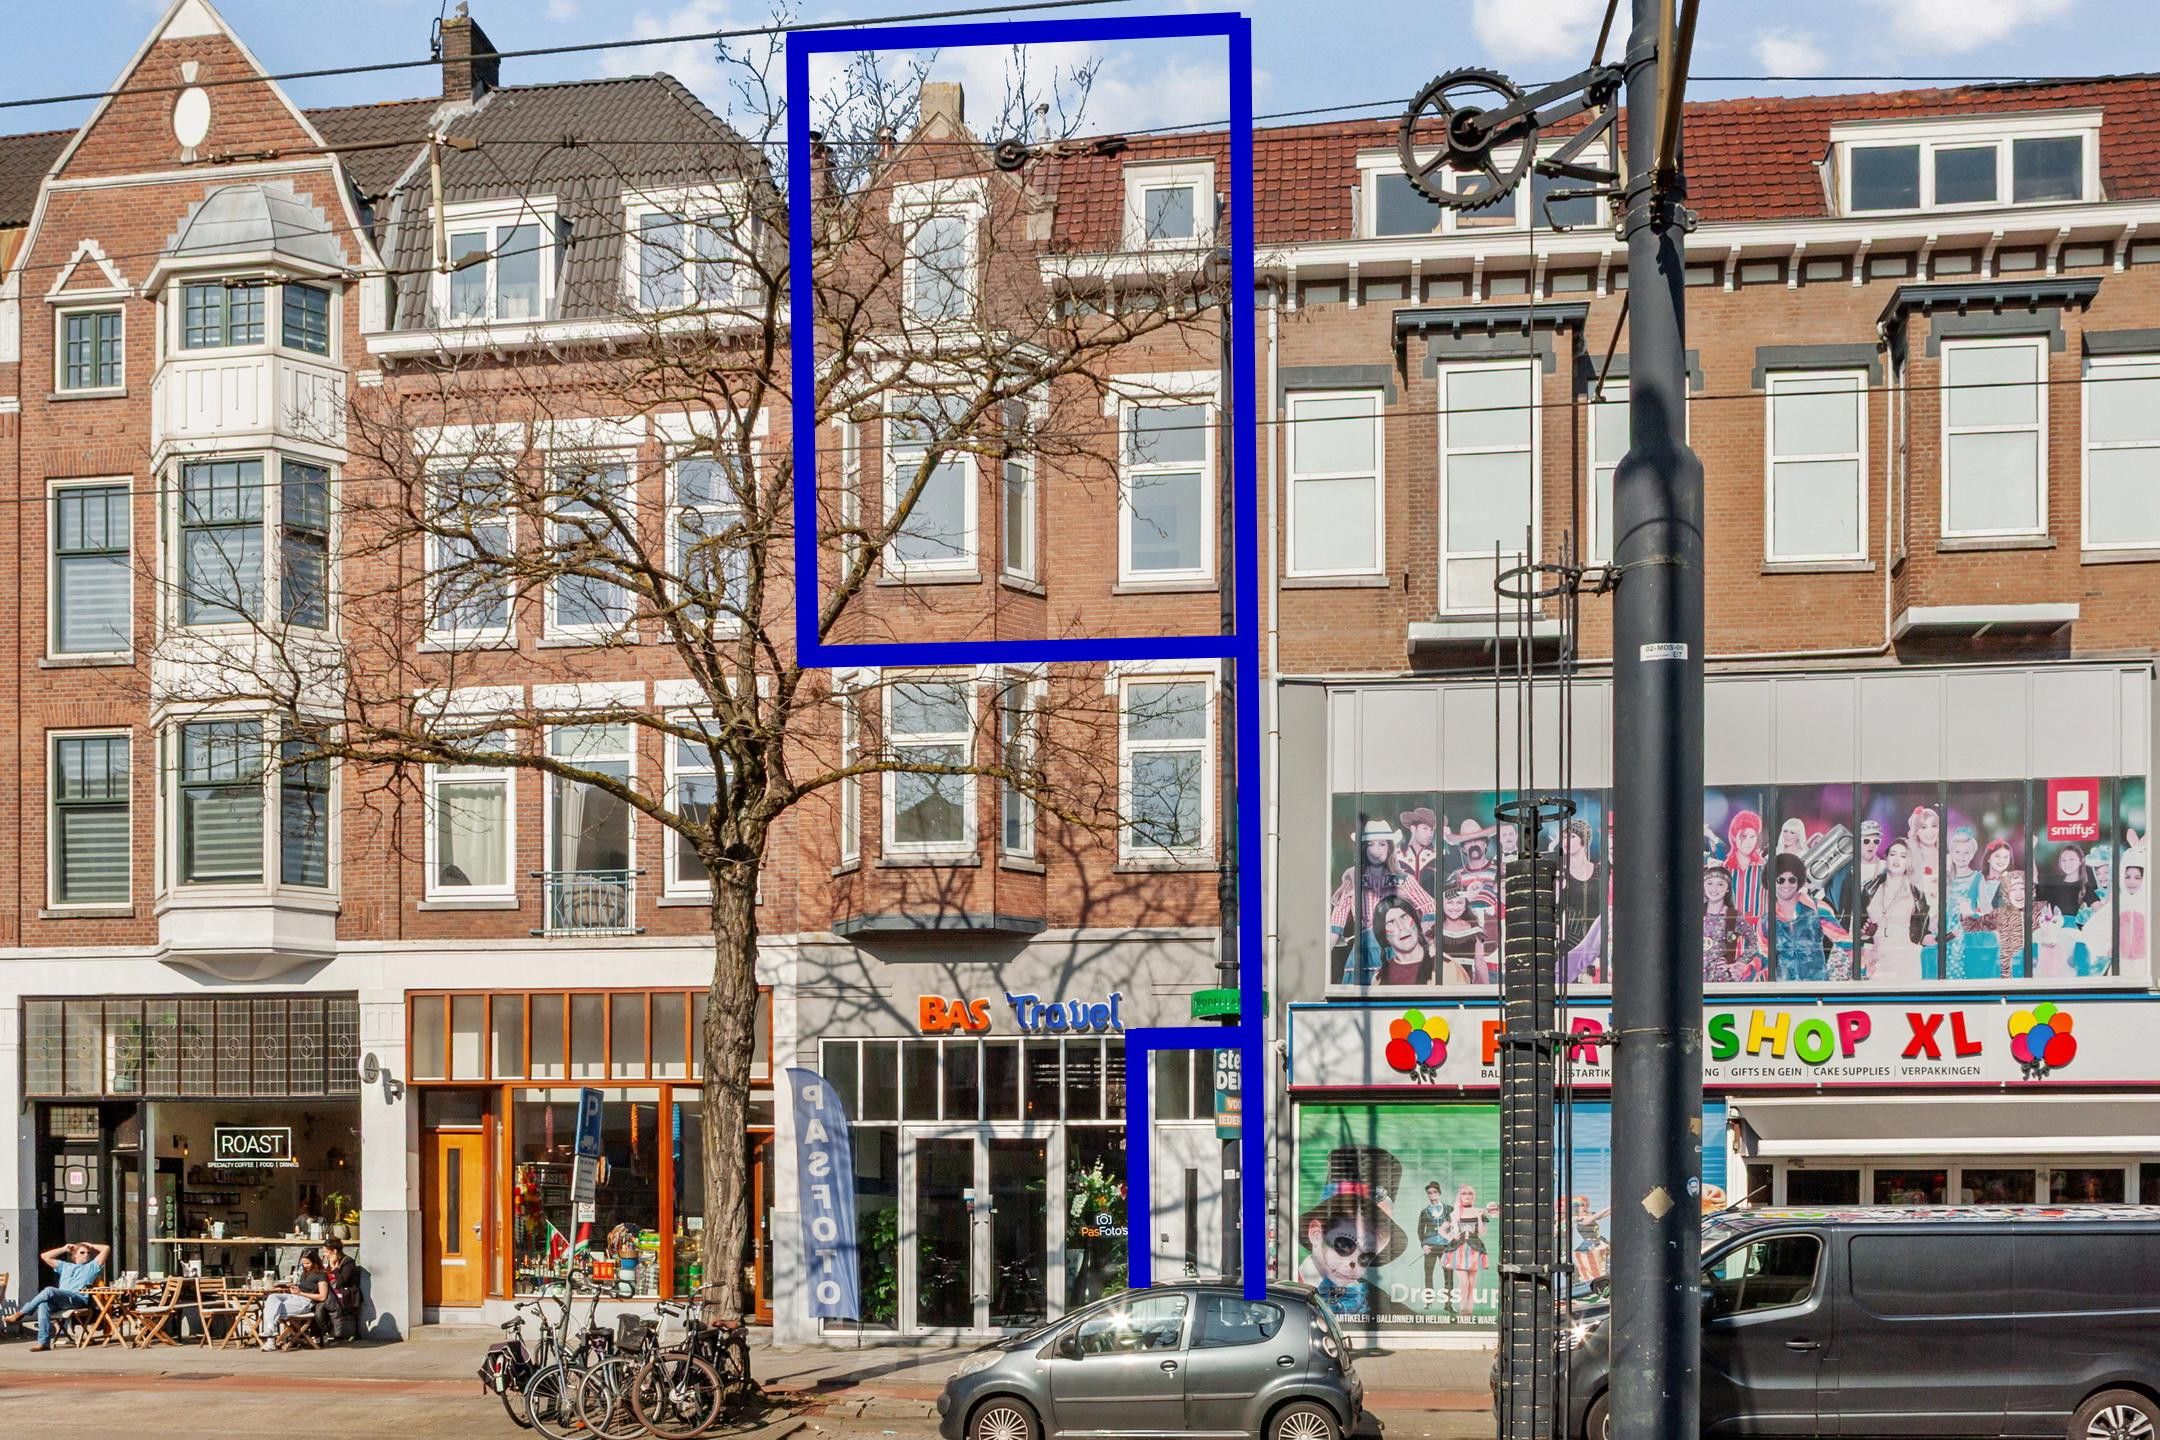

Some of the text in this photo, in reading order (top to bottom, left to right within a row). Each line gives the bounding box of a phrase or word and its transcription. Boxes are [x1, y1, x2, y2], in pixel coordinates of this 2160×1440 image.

[2051, 823, 2095, 838] smiffys
[919, 992, 1124, 1034] BAS Travel
[1708, 1010, 1872, 1065] SHOP
[1901, 1011, 1983, 1060] XL
[1731, 1067, 1760, 1077] GIFTS
[1762, 1067, 1775, 1077] EN
[1777, 1067, 1802, 1077] GEIN
[1813, 1067, 1840, 1076] CAKE
[1842, 1066, 1890, 1076] SUPPLIES
[1901, 1066, 1980, 1076] VERPAKKINGEN
[584, 1094, 599, 1127] P
[222, 1135, 283, 1153] ROAST
[1081, 1226, 1129, 1237] PasFoto's
[1390, 1283, 1462, 1304] Dress
[1376, 1314, 1414, 1324] BALLONNEN
[1415, 1315, 1425, 1324] EN
[1425, 1315, 1450, 1324] HELIUM
[1456, 1316, 1476, 1324] TABLE
[1478, 1316, 1497, 1325] WARE
